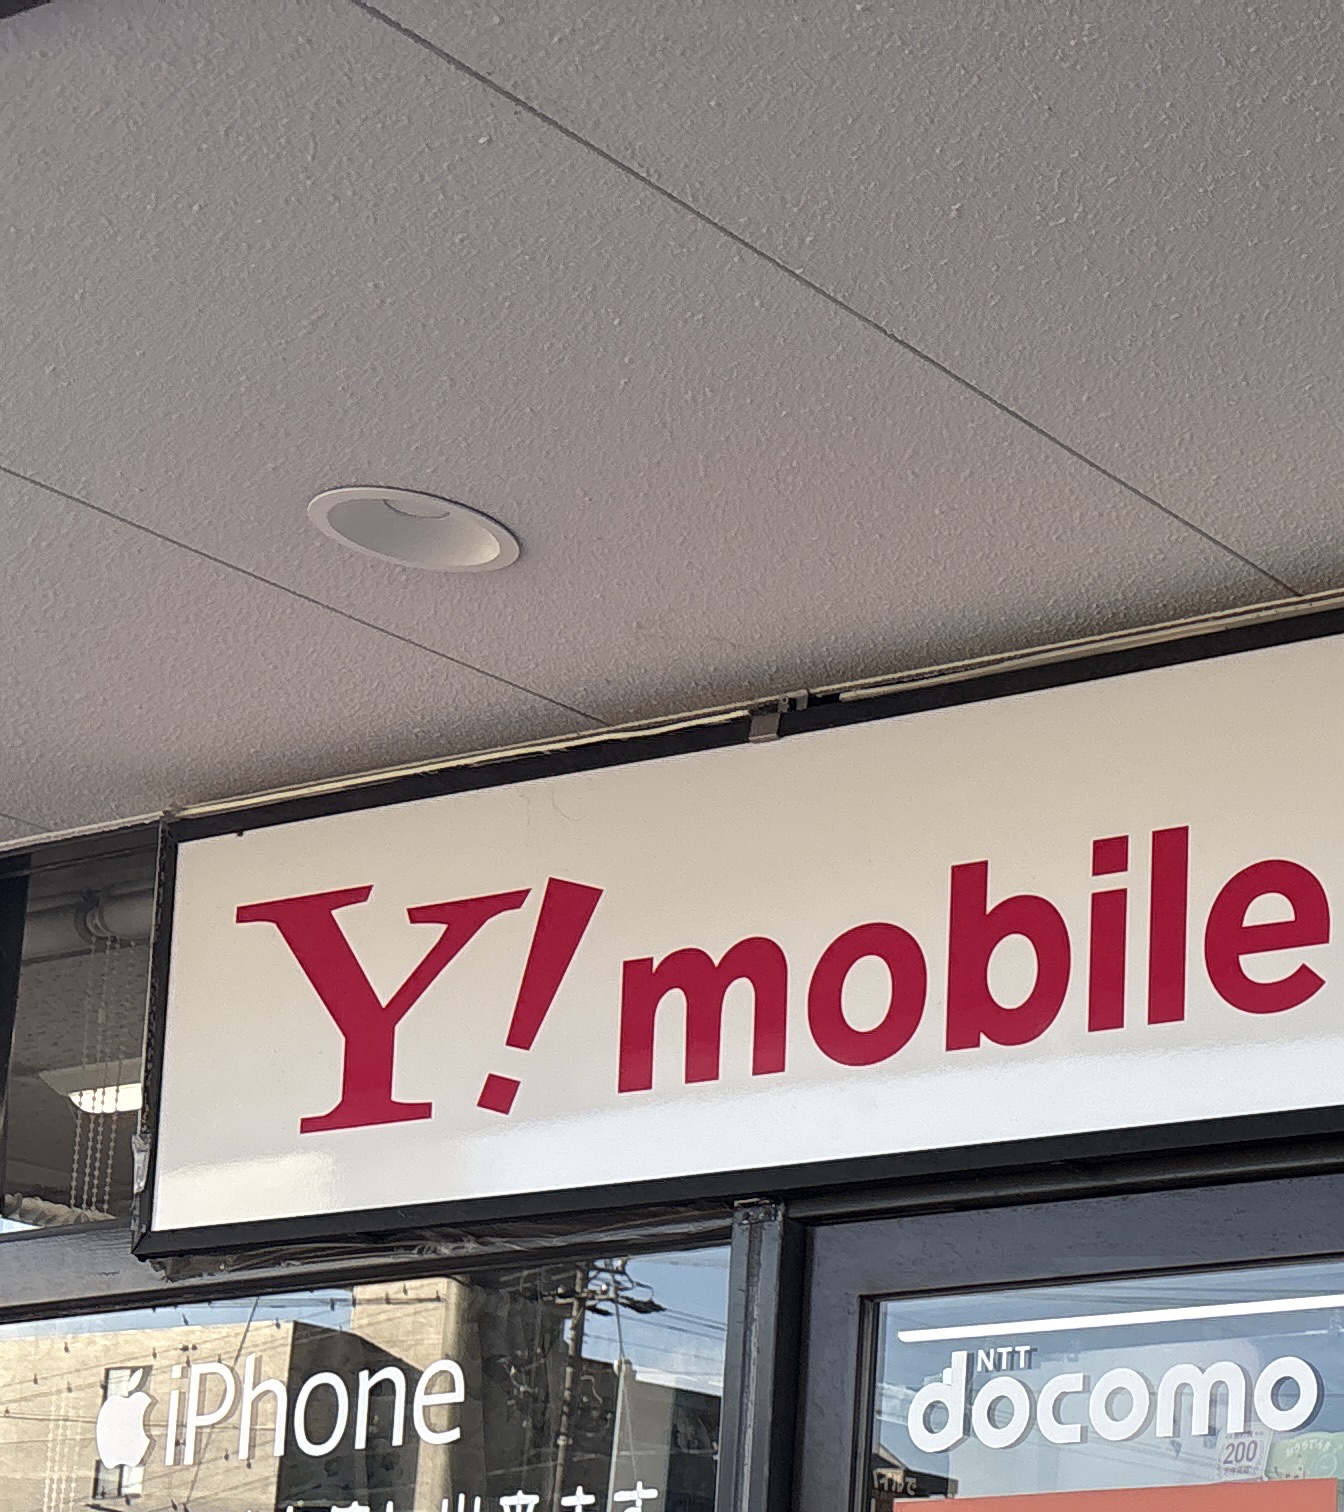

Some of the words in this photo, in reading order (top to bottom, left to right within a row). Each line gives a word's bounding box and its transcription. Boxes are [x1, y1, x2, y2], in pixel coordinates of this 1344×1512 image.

[235, 876, 604, 1135] Y!
[617, 824, 1332, 1095] mobile
[164, 1354, 466, 1466] iPhone
[906, 1350, 1319, 1454] docomo
[976, 1345, 1032, 1373] NTT
